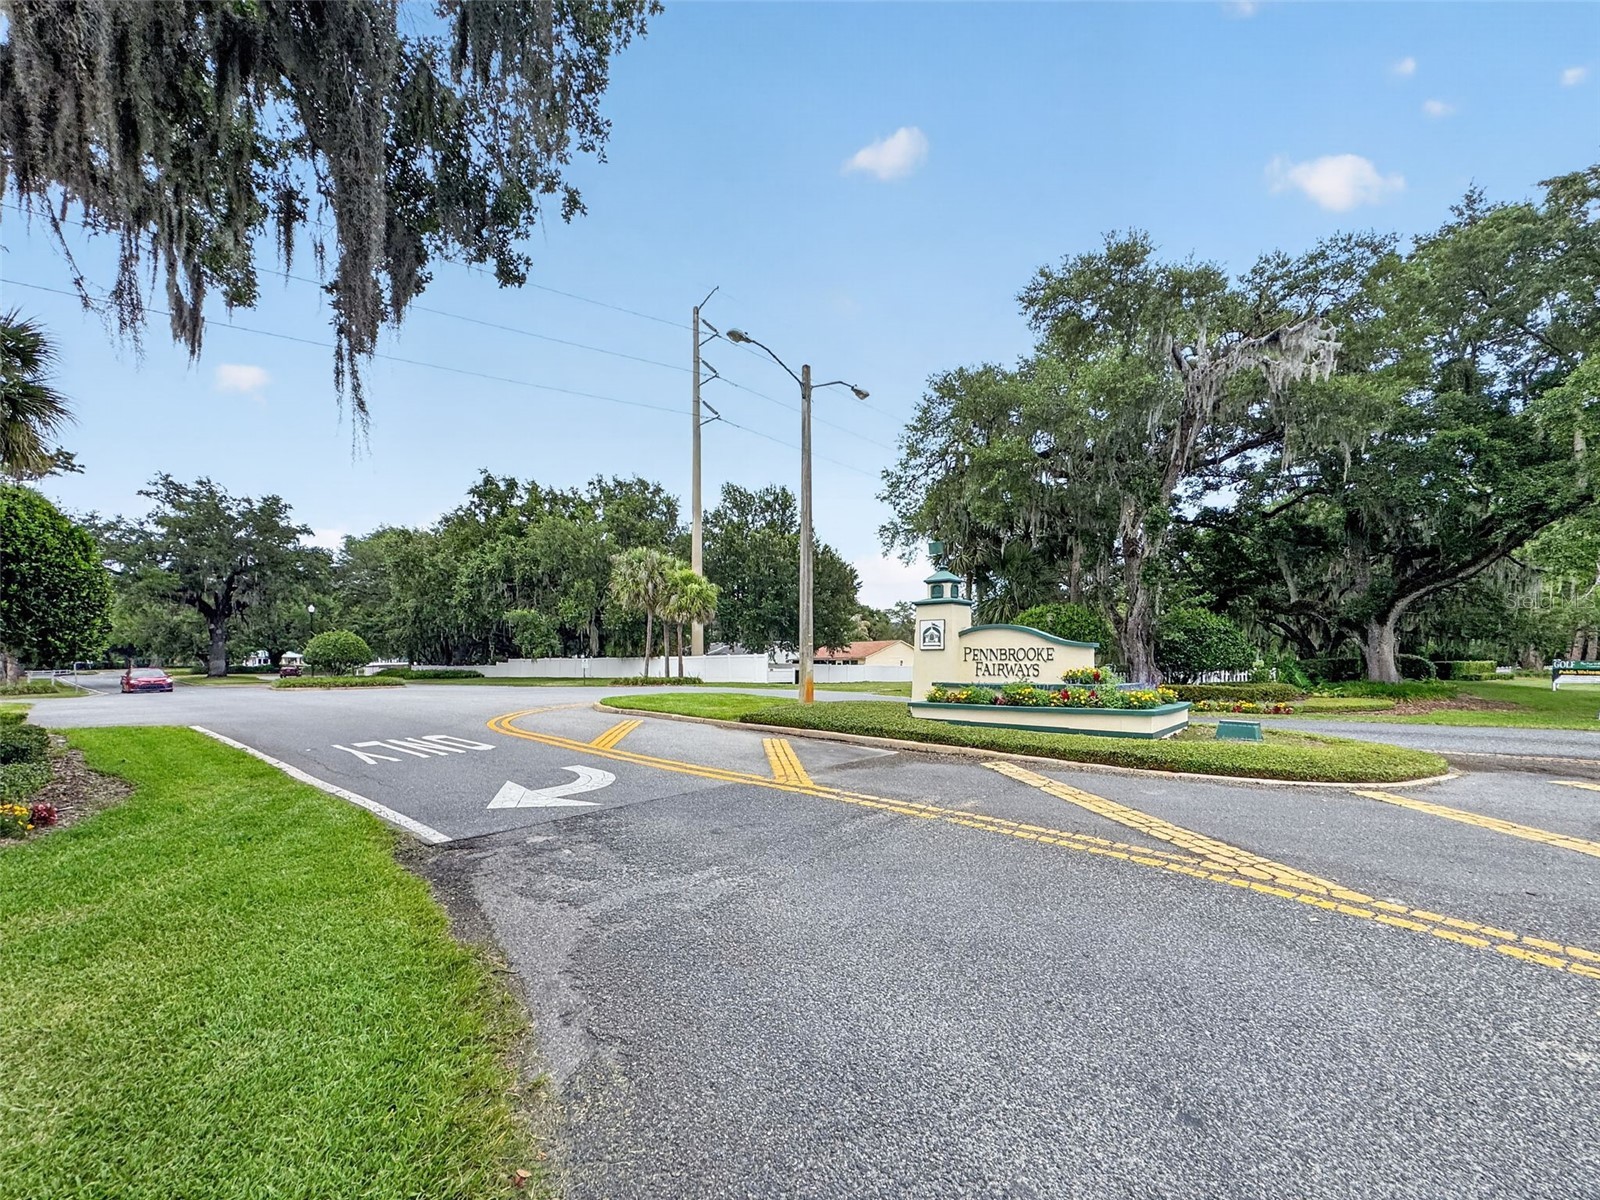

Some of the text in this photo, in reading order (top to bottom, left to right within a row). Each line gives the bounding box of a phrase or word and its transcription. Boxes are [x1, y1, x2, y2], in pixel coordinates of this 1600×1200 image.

[963, 646, 1055, 663] PENNBROOKE
[975, 662, 1040, 678] FAIRWAYS
[1553, 660, 1576, 669] GOLF
[331, 734, 496, 765] ONLY
